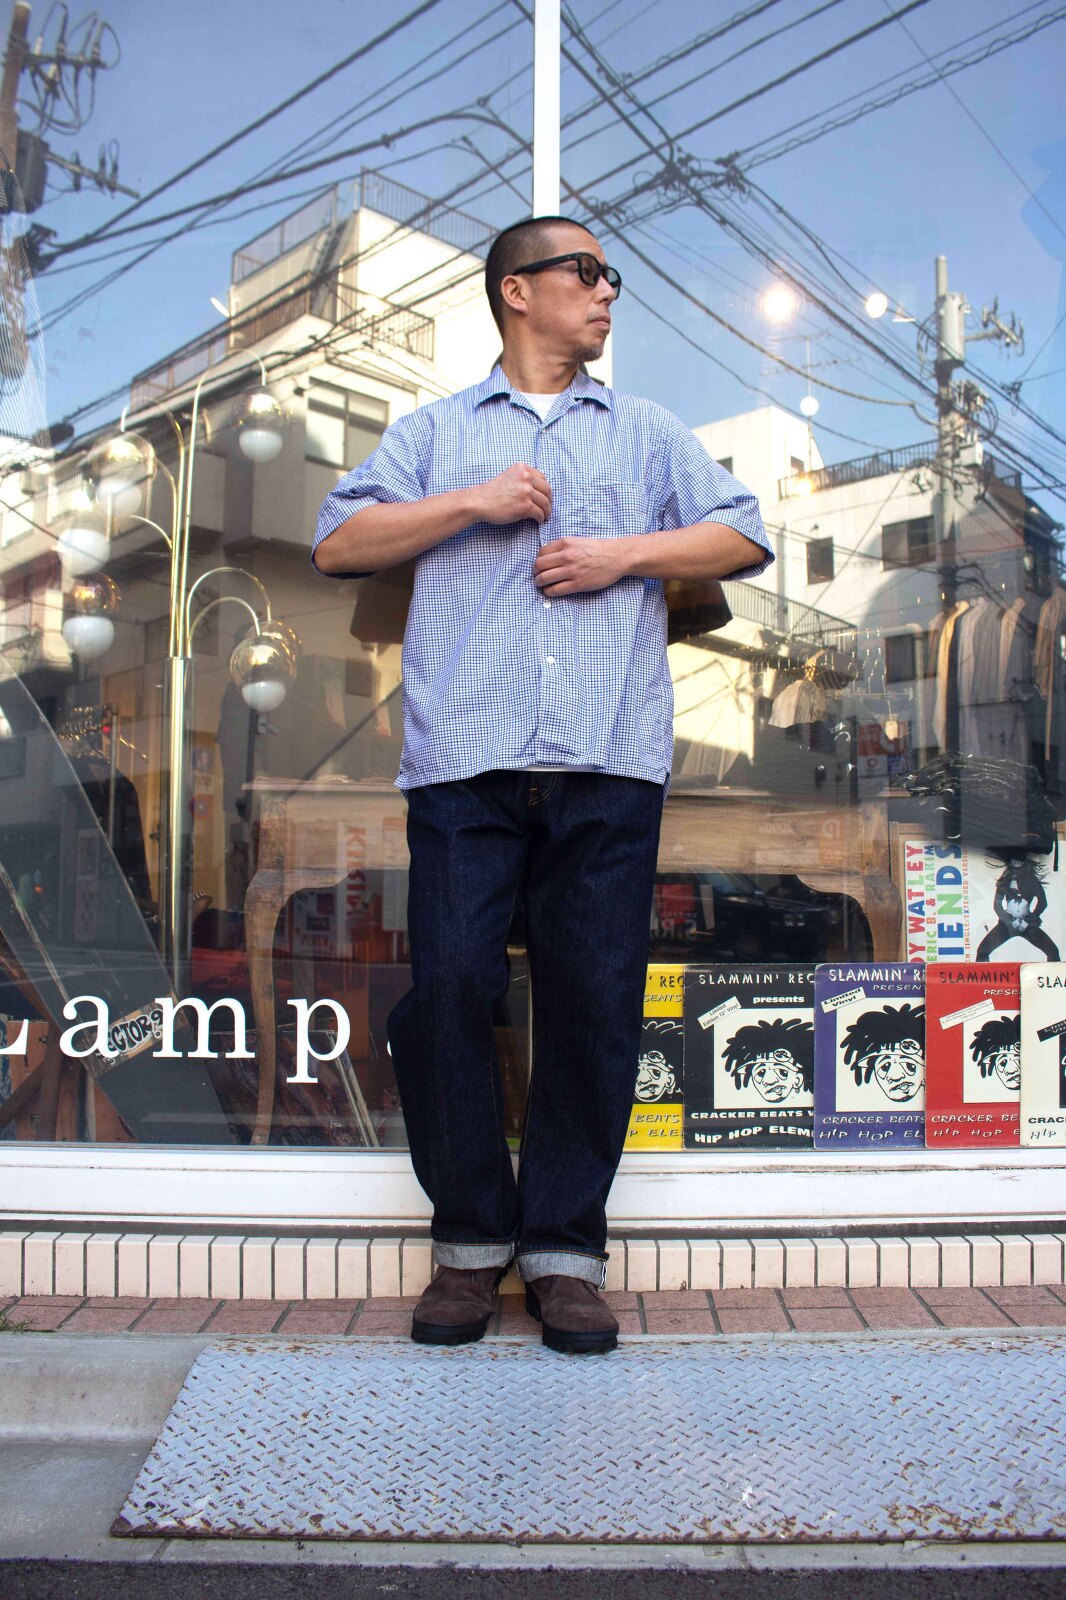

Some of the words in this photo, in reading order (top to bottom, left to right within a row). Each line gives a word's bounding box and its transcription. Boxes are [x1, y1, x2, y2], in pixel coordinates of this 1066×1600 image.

[924, 844, 936, 891] RAKIM
[906, 845, 926, 933] WATLEY
[925, 898, 936, 906] &
[926, 912, 937, 924] B.
[926, 931, 938, 961] ERIC
[699, 973, 779, 985] SLAMMIN'
[829, 968, 906, 982] SLAMMIN'
[939, 971, 1015, 984] SLAMMIN'
[1037, 976, 1066, 988] SLA
[752, 995, 805, 1004] presents
[635, 1114, 680, 1123] BEATS
[760, 1110, 803, 1118] BEATS
[931, 1114, 994, 1124] CRACKER
[1028, 1116, 1066, 1124] CRAC
[822, 1116, 883, 1125] CRACKER
[648, 1129, 684, 1137] ELE
[694, 1133, 722, 1144] HIP
[728, 1126, 763, 1140] HOP
[769, 1125, 814, 1138] ELEM
[819, 1128, 848, 1139] HIP
[858, 1130, 894, 1141] HOP
[903, 1130, 924, 1139] EL
[933, 1128, 960, 1137] HIP
[971, 1129, 1002, 1138] HOP
[1030, 1128, 1057, 1140] HIP
